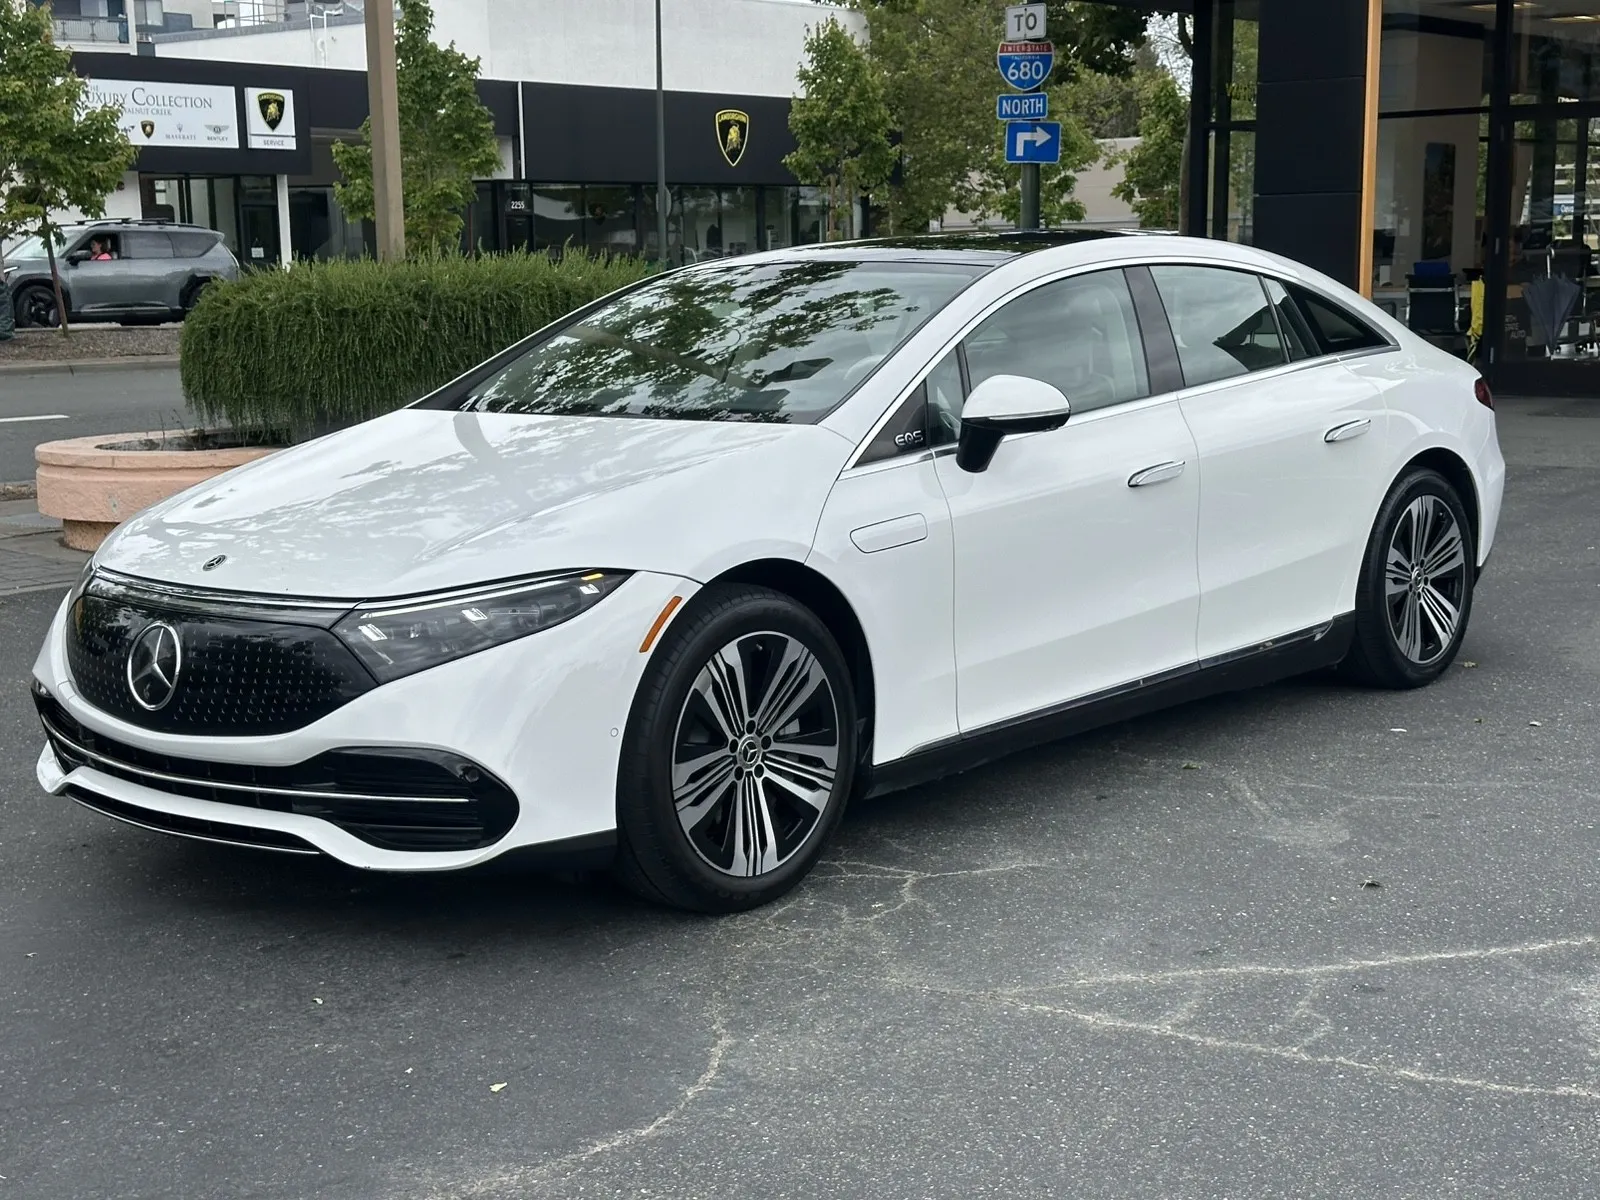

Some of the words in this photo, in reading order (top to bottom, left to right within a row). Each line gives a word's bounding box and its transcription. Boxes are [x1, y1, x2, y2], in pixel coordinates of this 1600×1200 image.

[1014, 13, 1037, 32] TO
[1003, 44, 1048, 52] INTERSTATE
[1008, 61, 1043, 80] 680
[86, 91, 128, 106] UXURY
[151, 108, 172, 116] CREEK
[1002, 98, 1043, 115] NORTH
[511, 200, 525, 209] 2255
[894, 430, 924, 446] EQS
